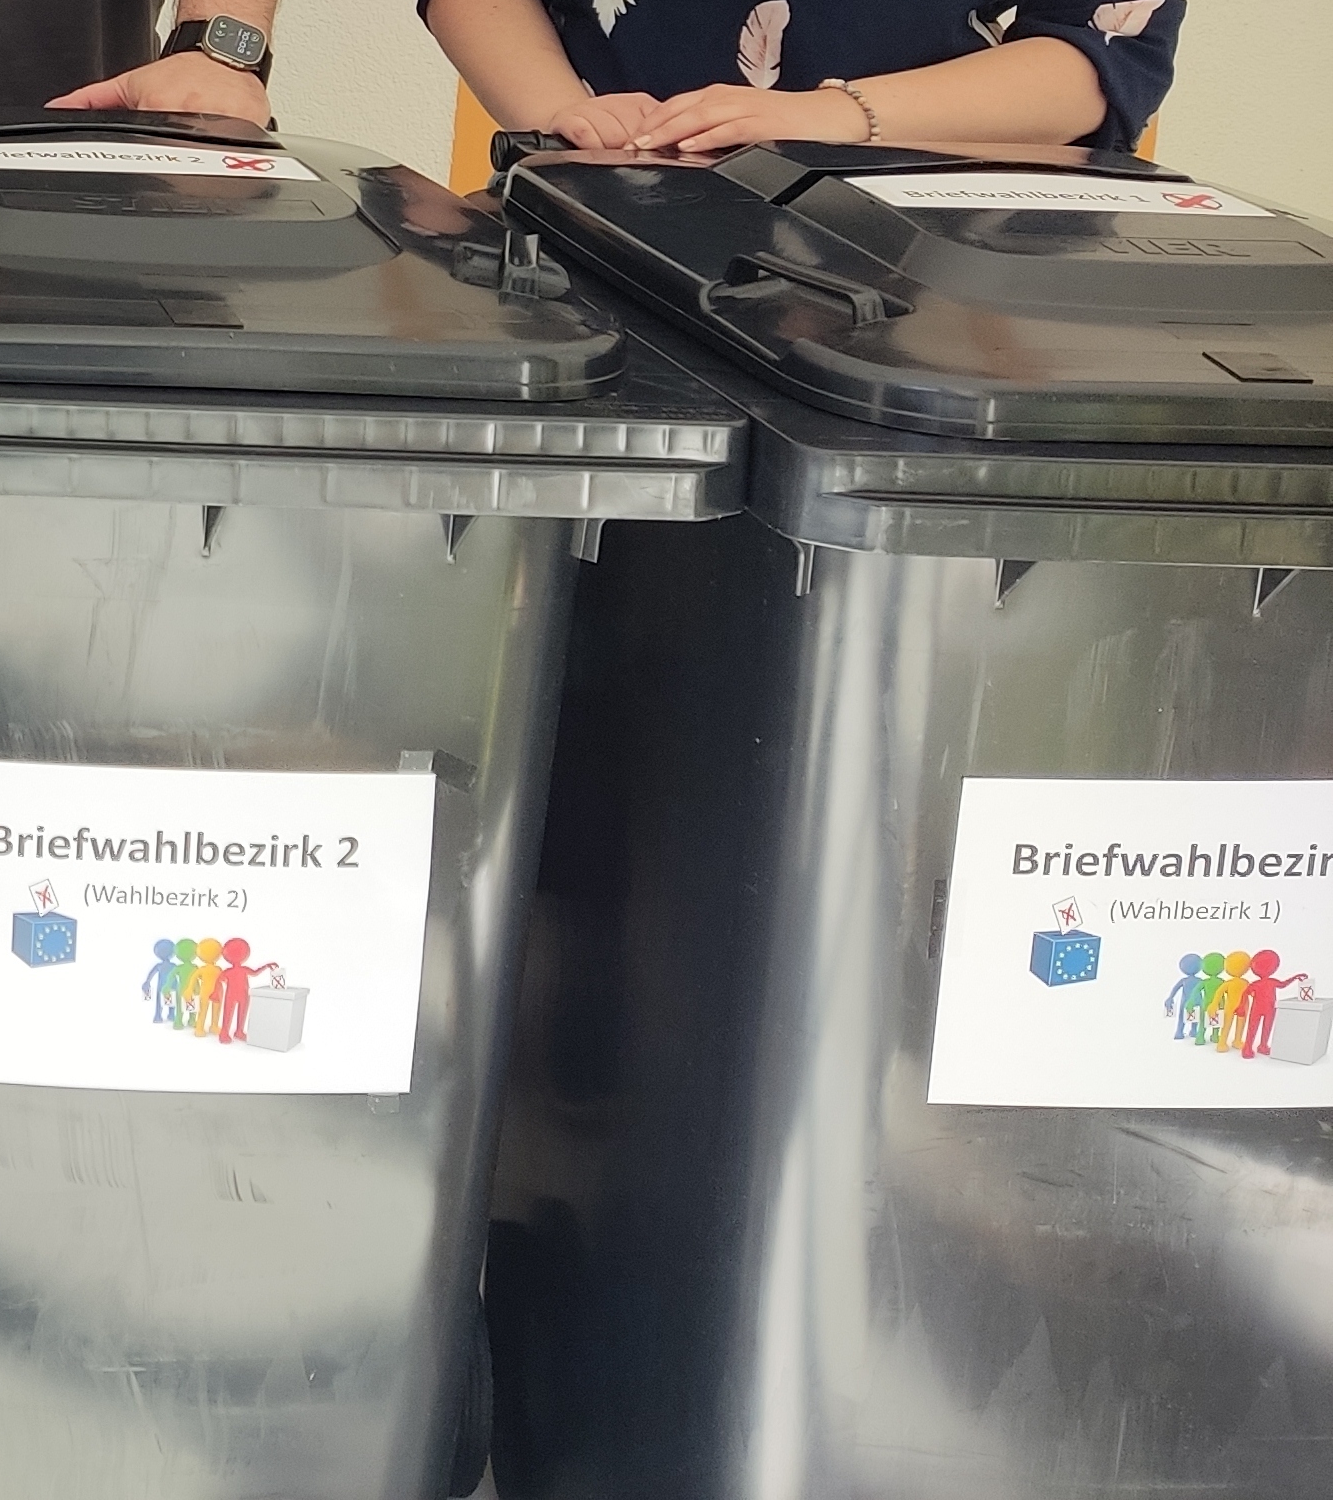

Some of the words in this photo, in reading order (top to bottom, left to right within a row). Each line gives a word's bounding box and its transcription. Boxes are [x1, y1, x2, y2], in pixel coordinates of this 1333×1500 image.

[188, 155, 205, 165] 2
[902, 188, 1130, 203] Briefwahlbezirk
[1131, 194, 1151, 203] 1
[336, 836, 361, 869] 2
[1011, 842, 1333, 878] Briefwahlbezir
[83, 883, 220, 910] (Wahlbezirk
[225, 887, 249, 913] 2)
[1109, 899, 1252, 924] (Wahlbezirk
[1258, 899, 1282, 924] 1)
